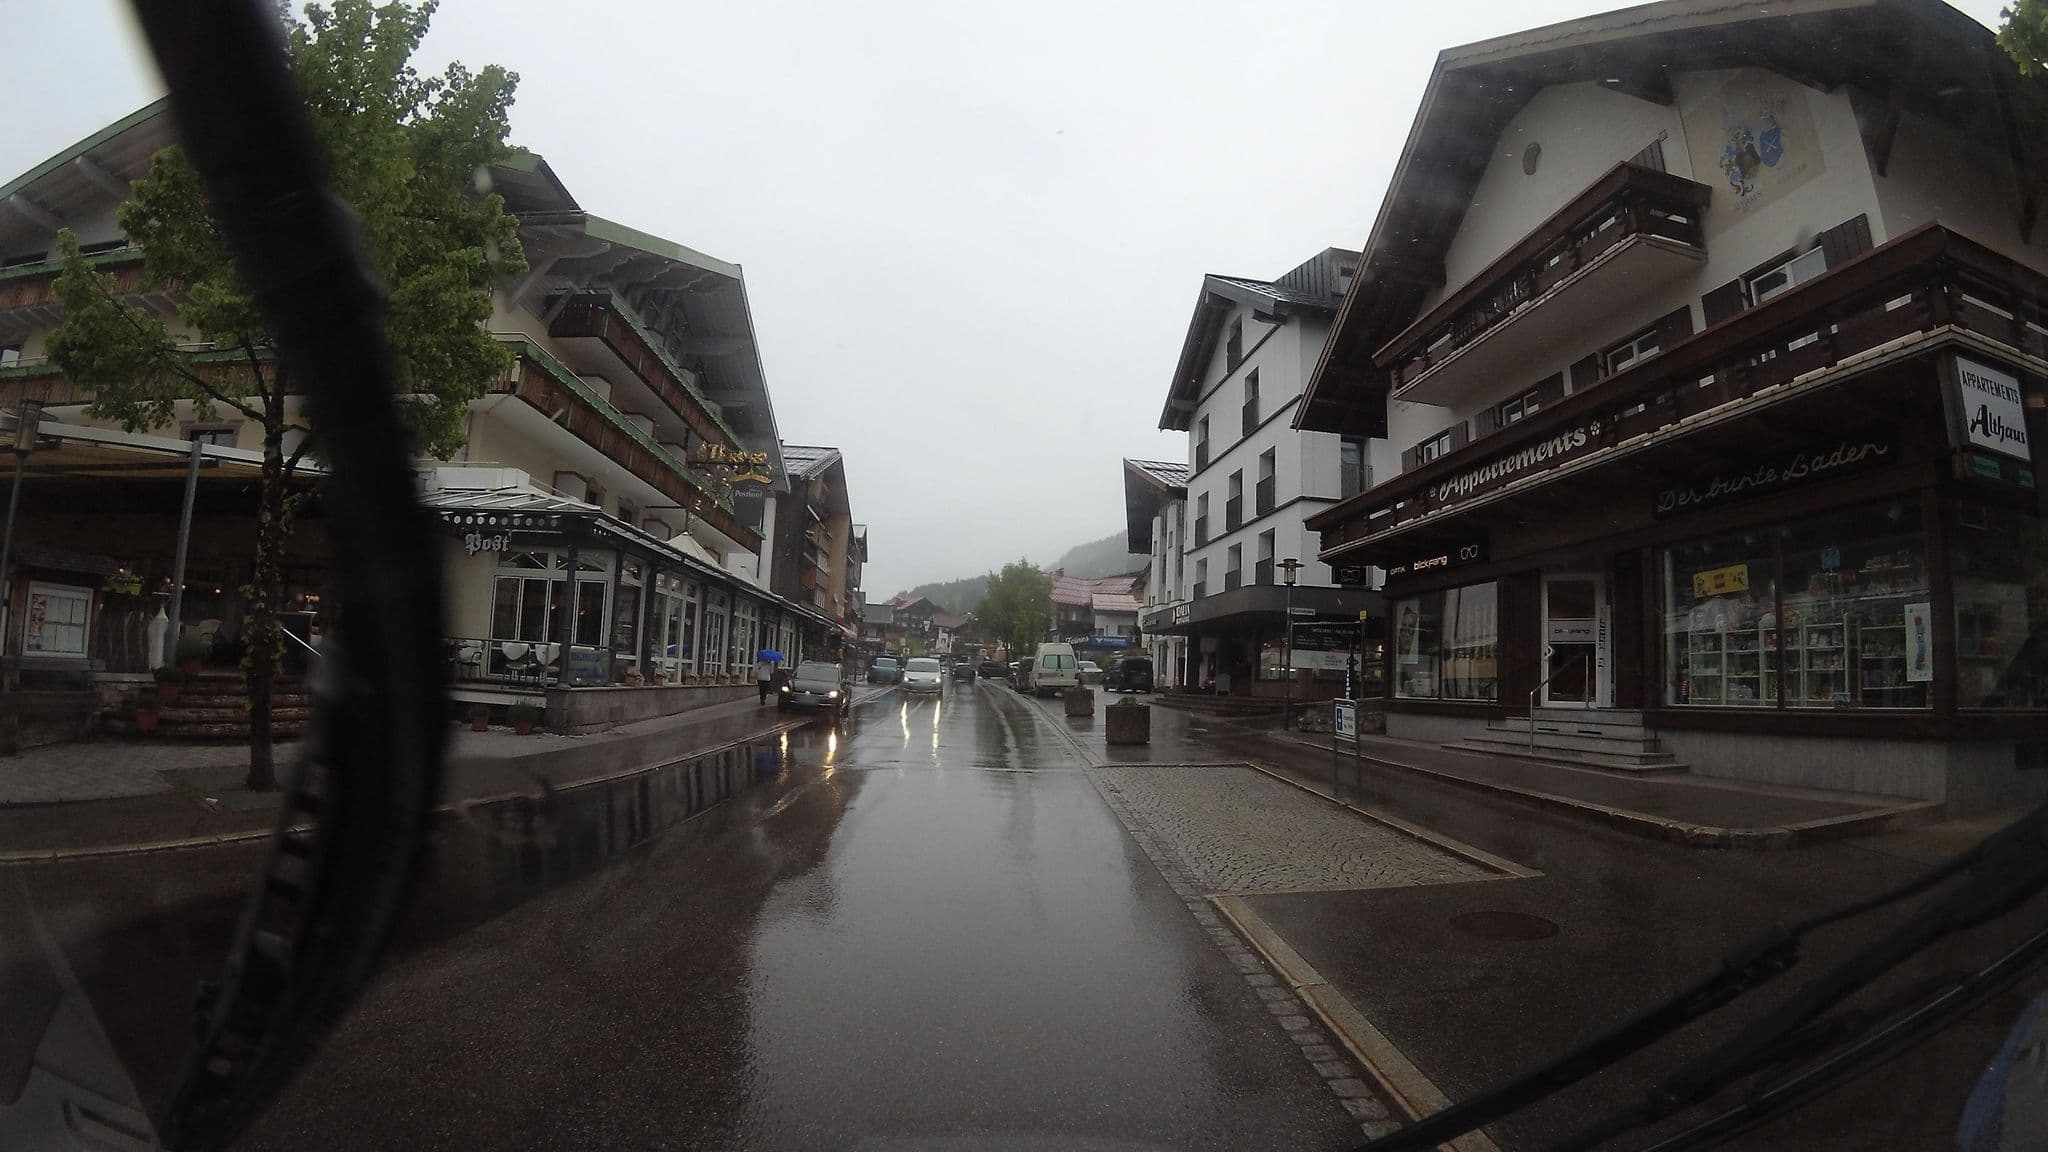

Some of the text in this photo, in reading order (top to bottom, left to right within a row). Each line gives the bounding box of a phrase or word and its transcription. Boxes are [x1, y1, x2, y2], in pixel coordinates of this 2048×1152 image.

[1961, 369, 2019, 404] APPARTEMENTS
[1969, 404, 2026, 444] Althaus
[1440, 426, 1588, 501] Appartements
[1657, 441, 1889, 513] Der bunte Laden
[465, 532, 510, 556] Post
